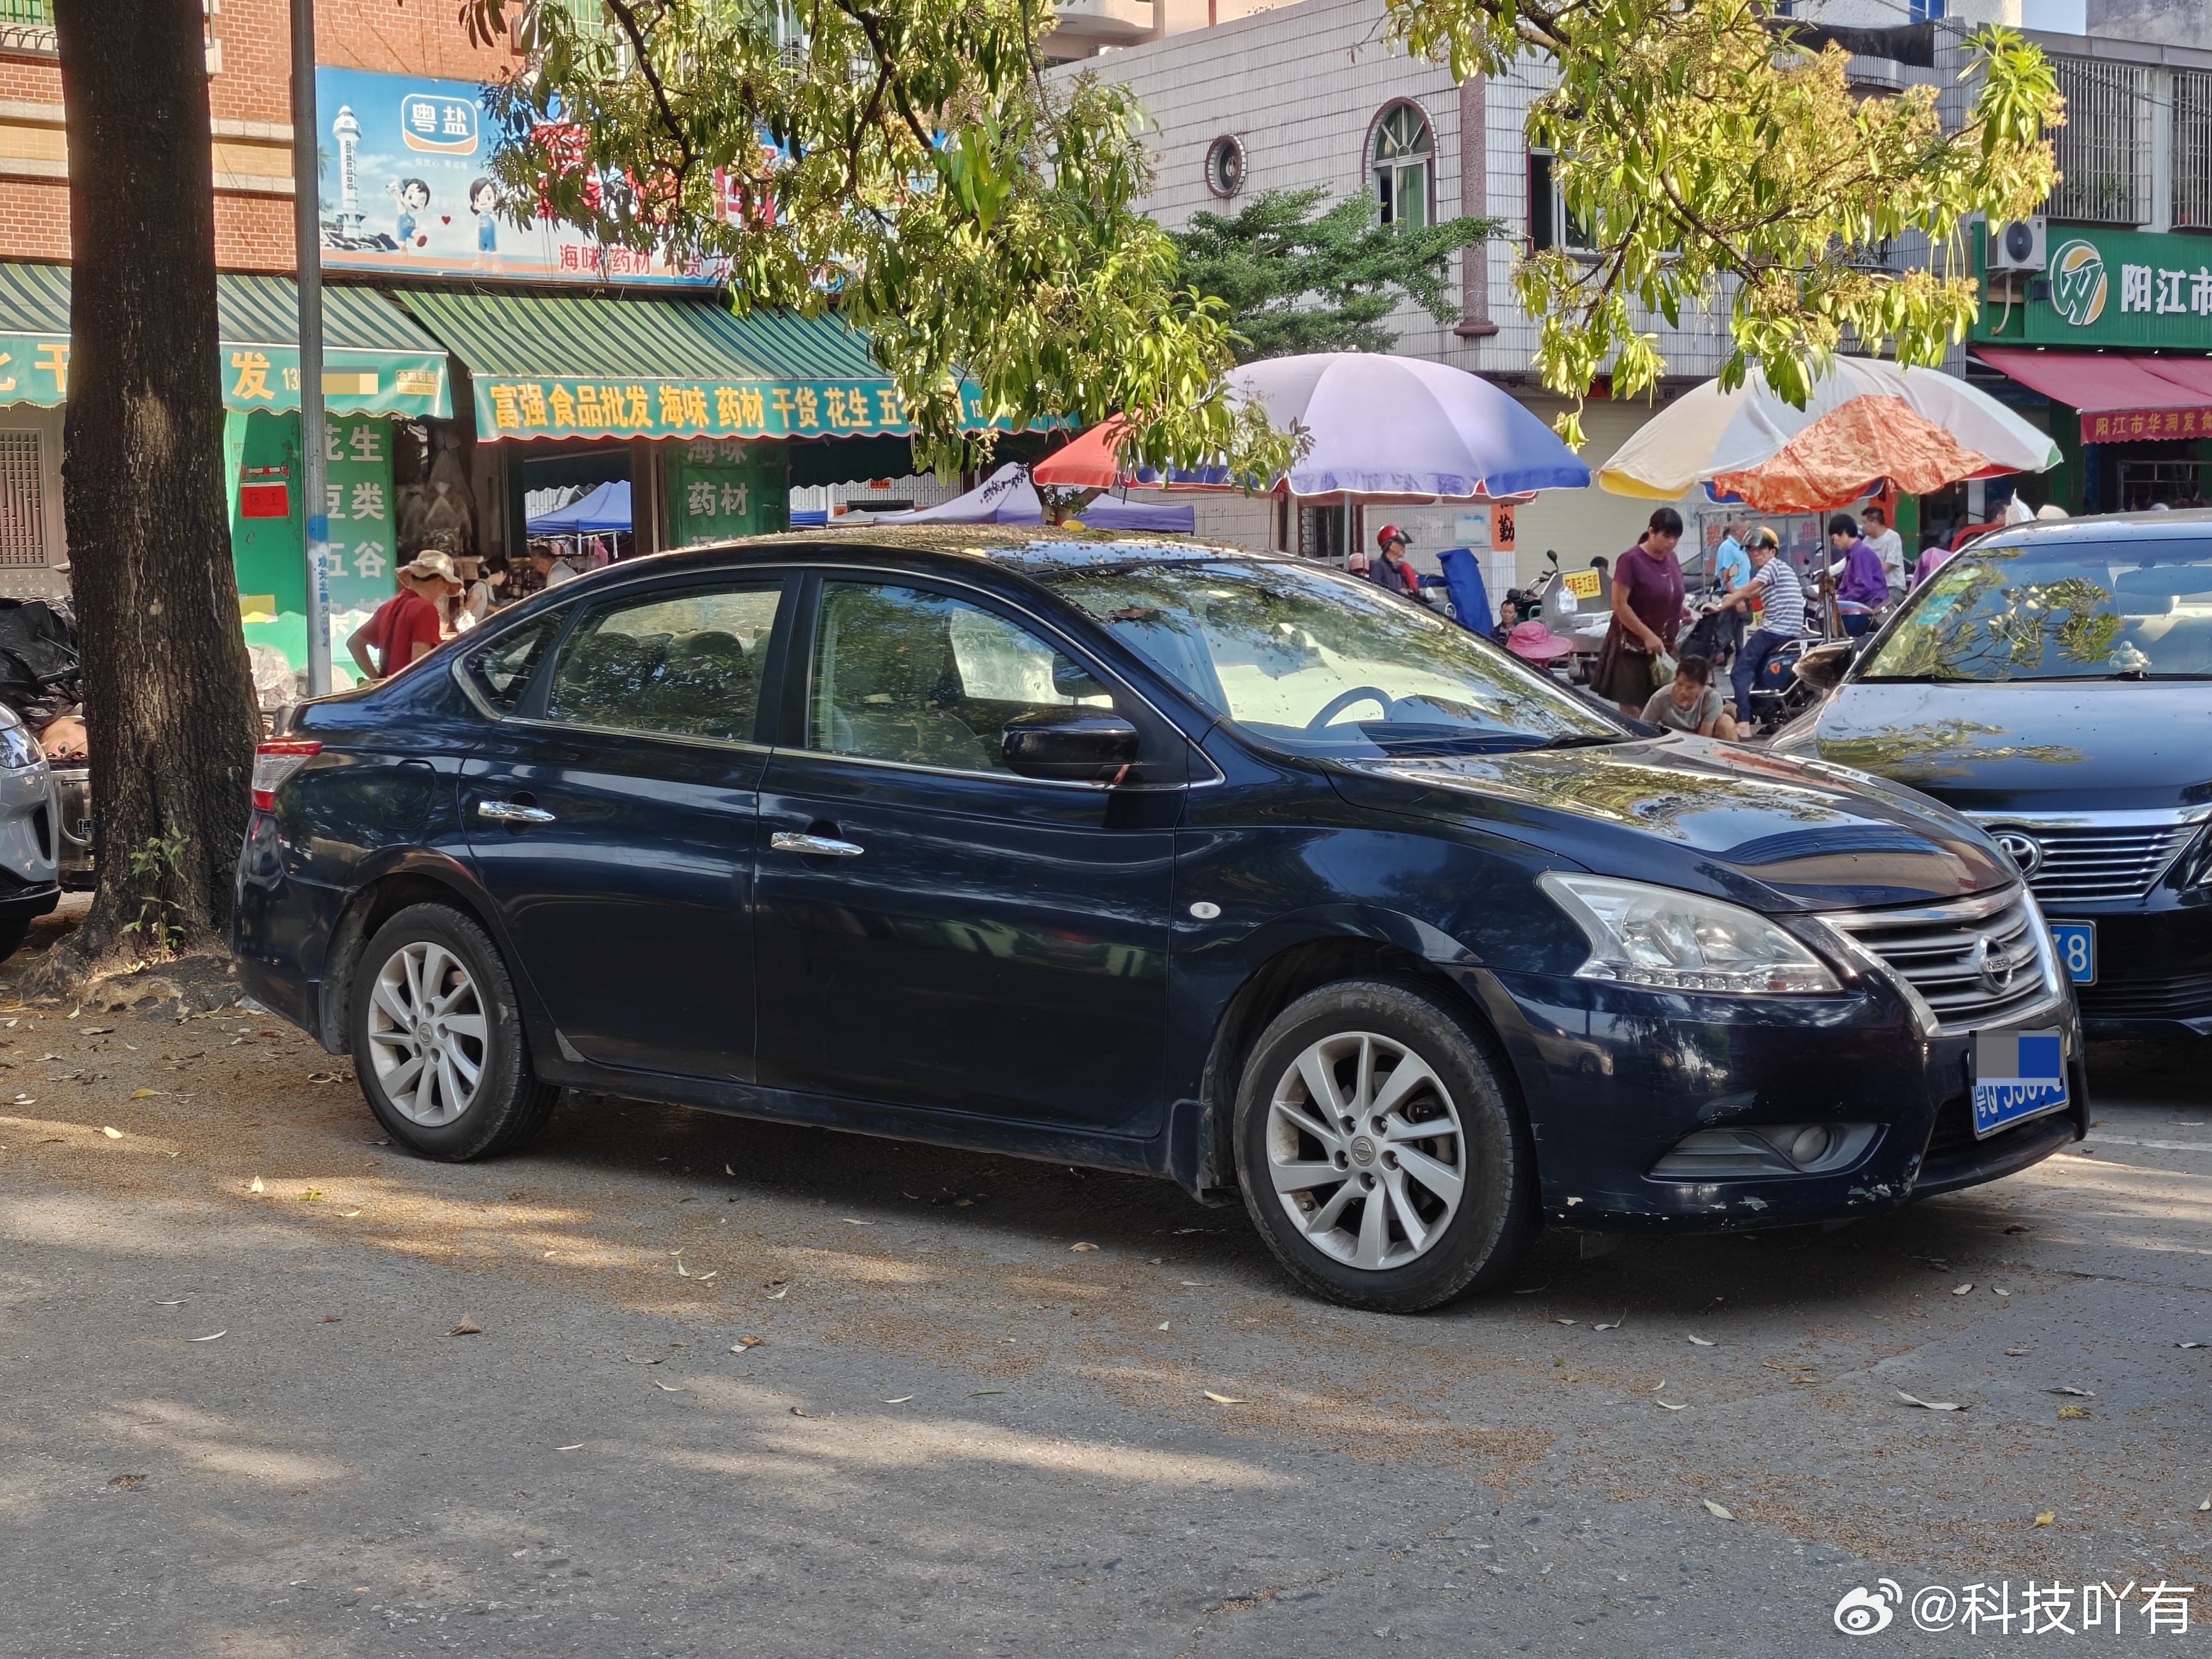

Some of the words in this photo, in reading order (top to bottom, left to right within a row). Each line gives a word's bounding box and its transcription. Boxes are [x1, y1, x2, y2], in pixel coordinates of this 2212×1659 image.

[412, 103, 469, 136] 粤盐
[2121, 264, 2212, 316] 阳江市
[490, 383, 653, 428] 富强食品批发
[658, 385, 710, 428] 海味
[714, 386, 765, 428] 药材
[772, 387, 819, 428] 干货
[824, 386, 872, 427] 花生
[687, 482, 748, 516] 药材
[328, 541, 387, 578] 五谷
